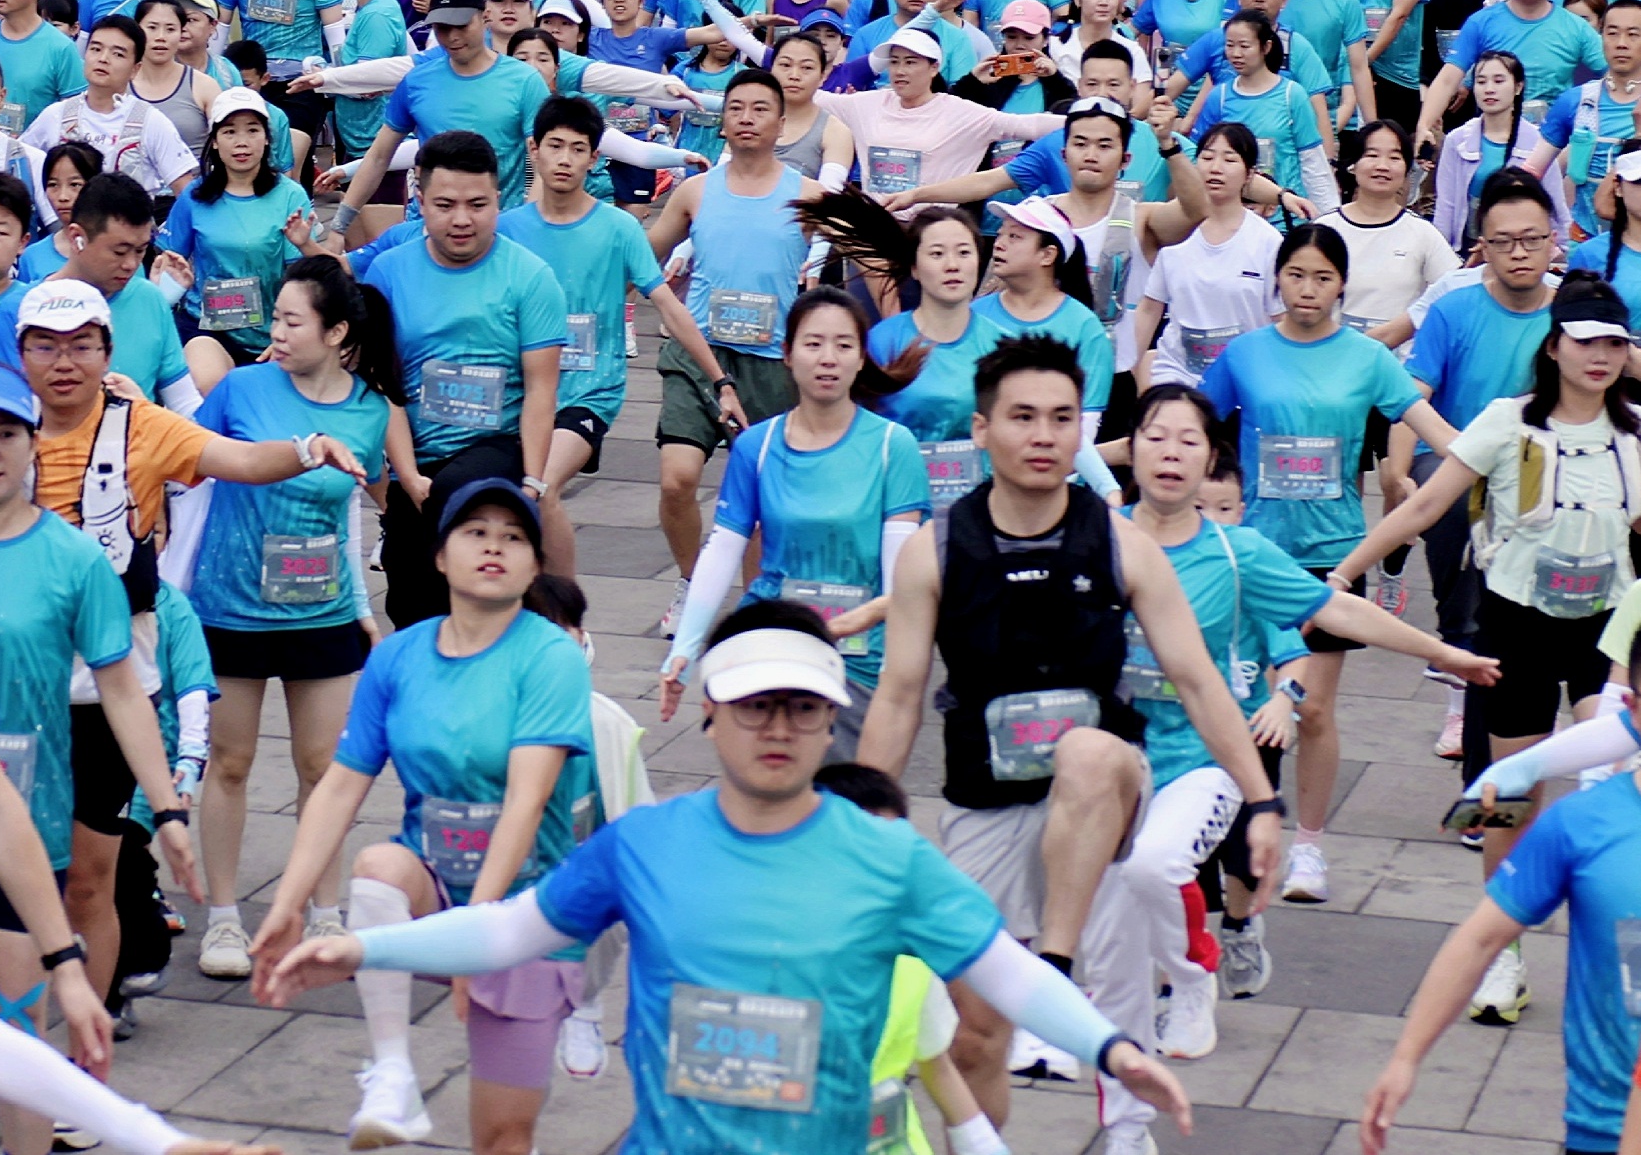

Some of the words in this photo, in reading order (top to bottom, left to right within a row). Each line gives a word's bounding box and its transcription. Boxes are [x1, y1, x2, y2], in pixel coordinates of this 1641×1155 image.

[38, 298, 86, 314] FUGA
[720, 306, 759, 322] 2092
[280, 556, 328, 575] 3025
[694, 1022, 779, 1061] 2094
